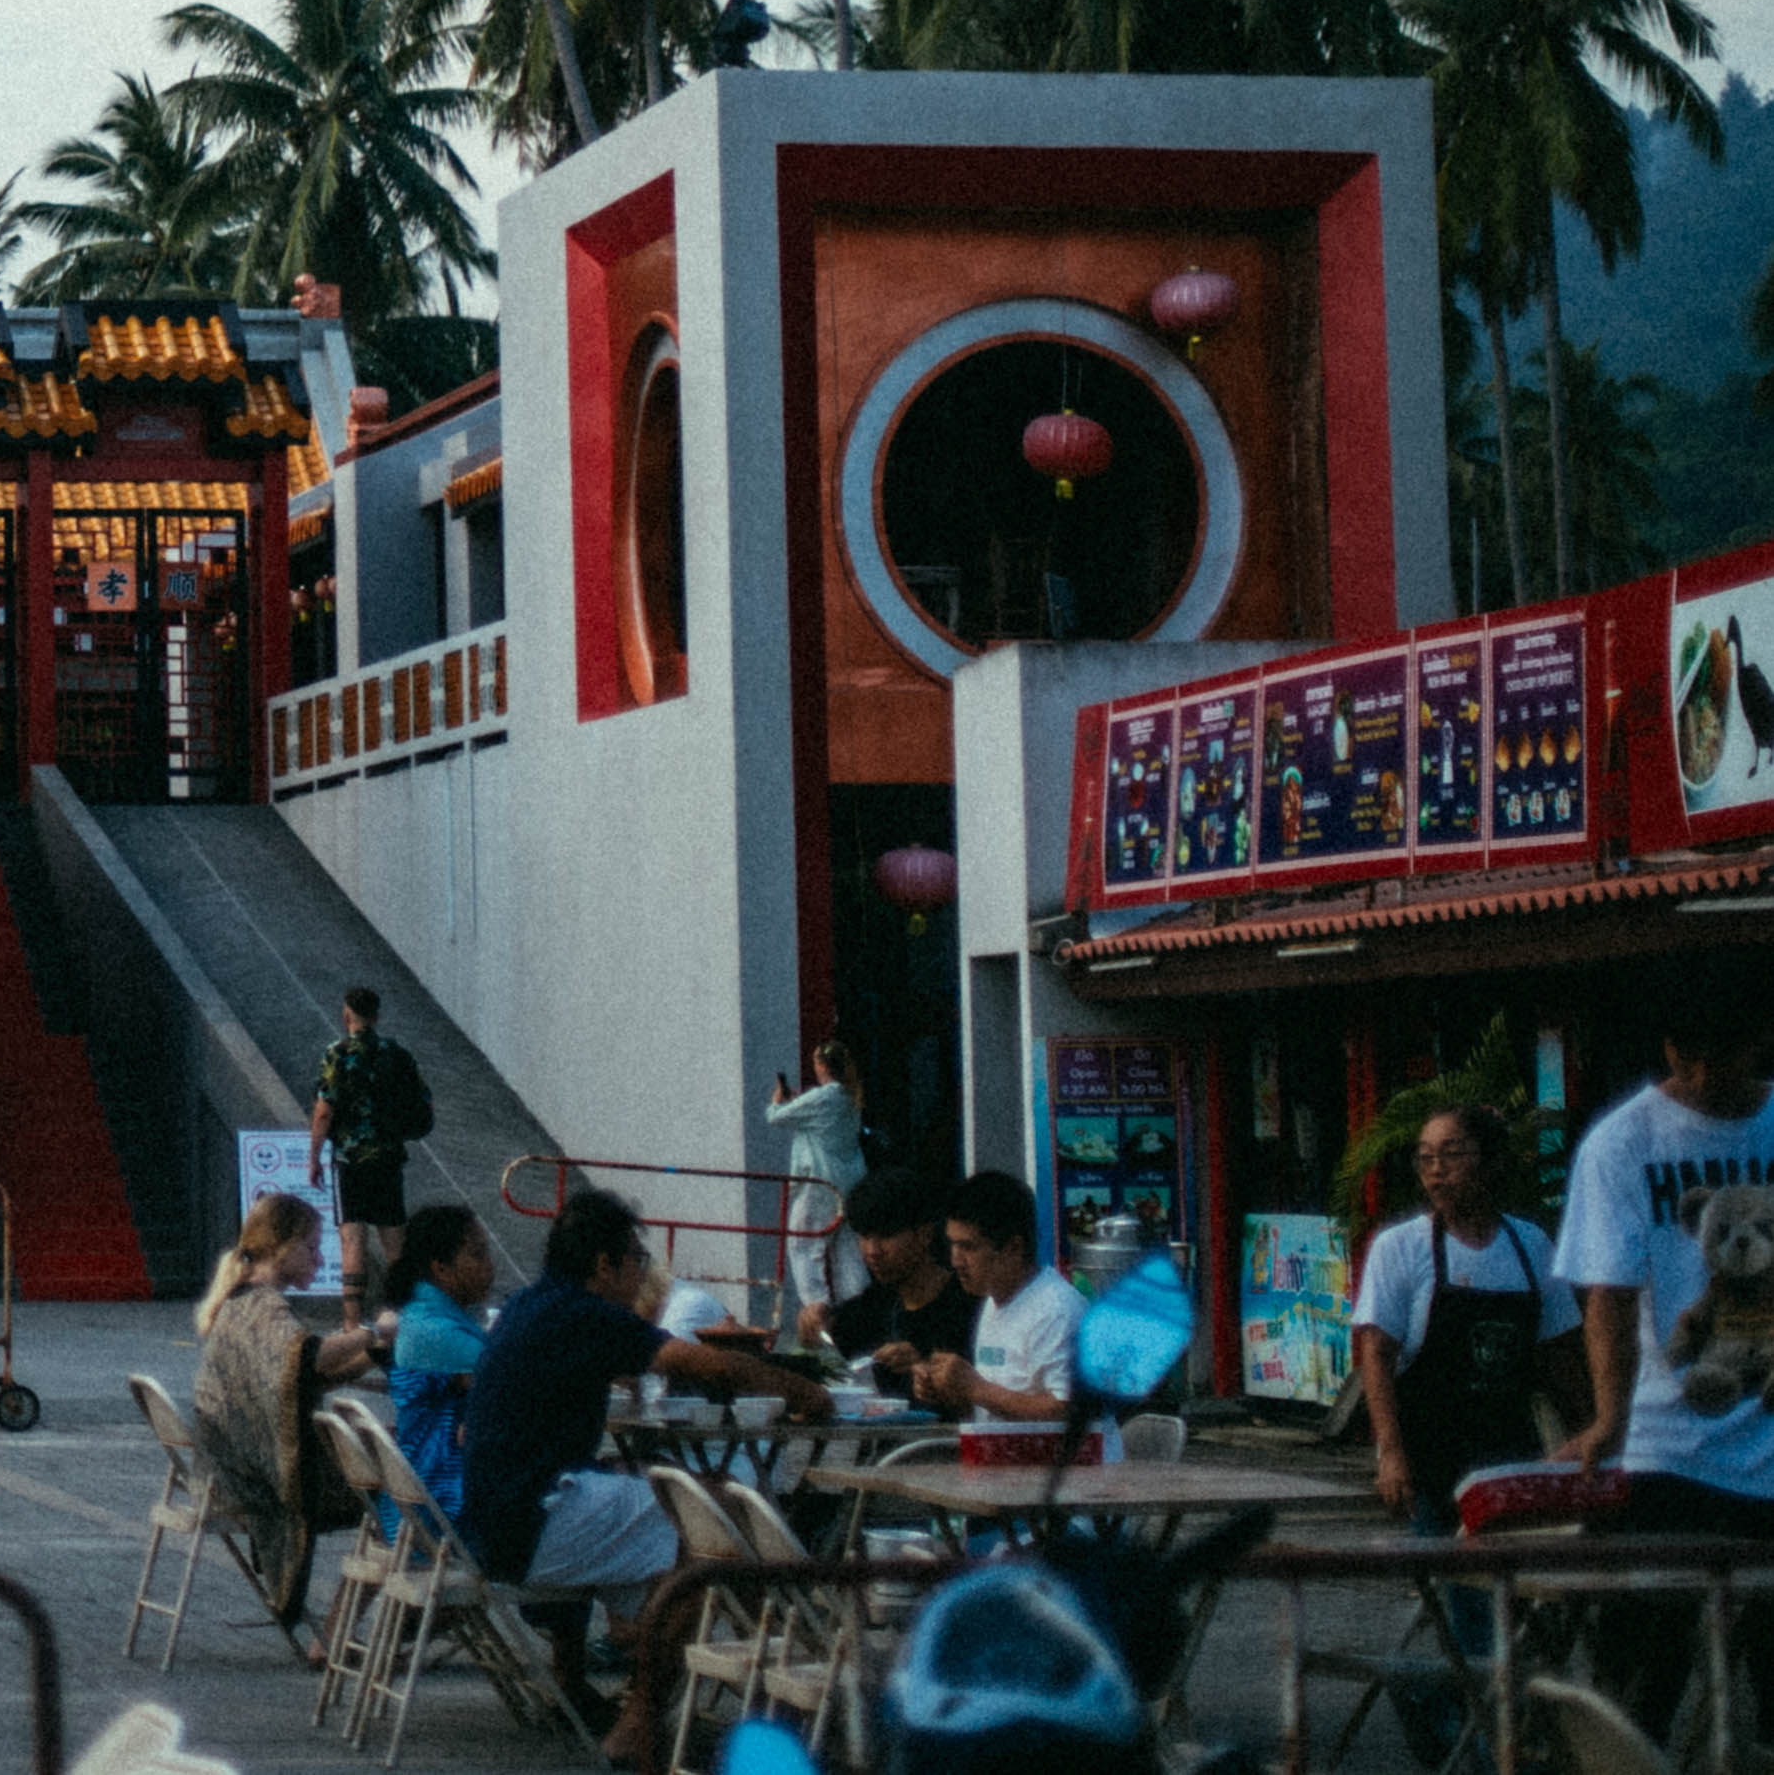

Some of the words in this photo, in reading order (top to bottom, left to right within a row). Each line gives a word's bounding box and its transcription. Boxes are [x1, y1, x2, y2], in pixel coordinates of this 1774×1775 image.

[96, 568, 130, 604] 孝
[165, 571, 198, 603] 顺
[1069, 1067, 1100, 1080] Open
[1127, 1066, 1159, 1079] Close
